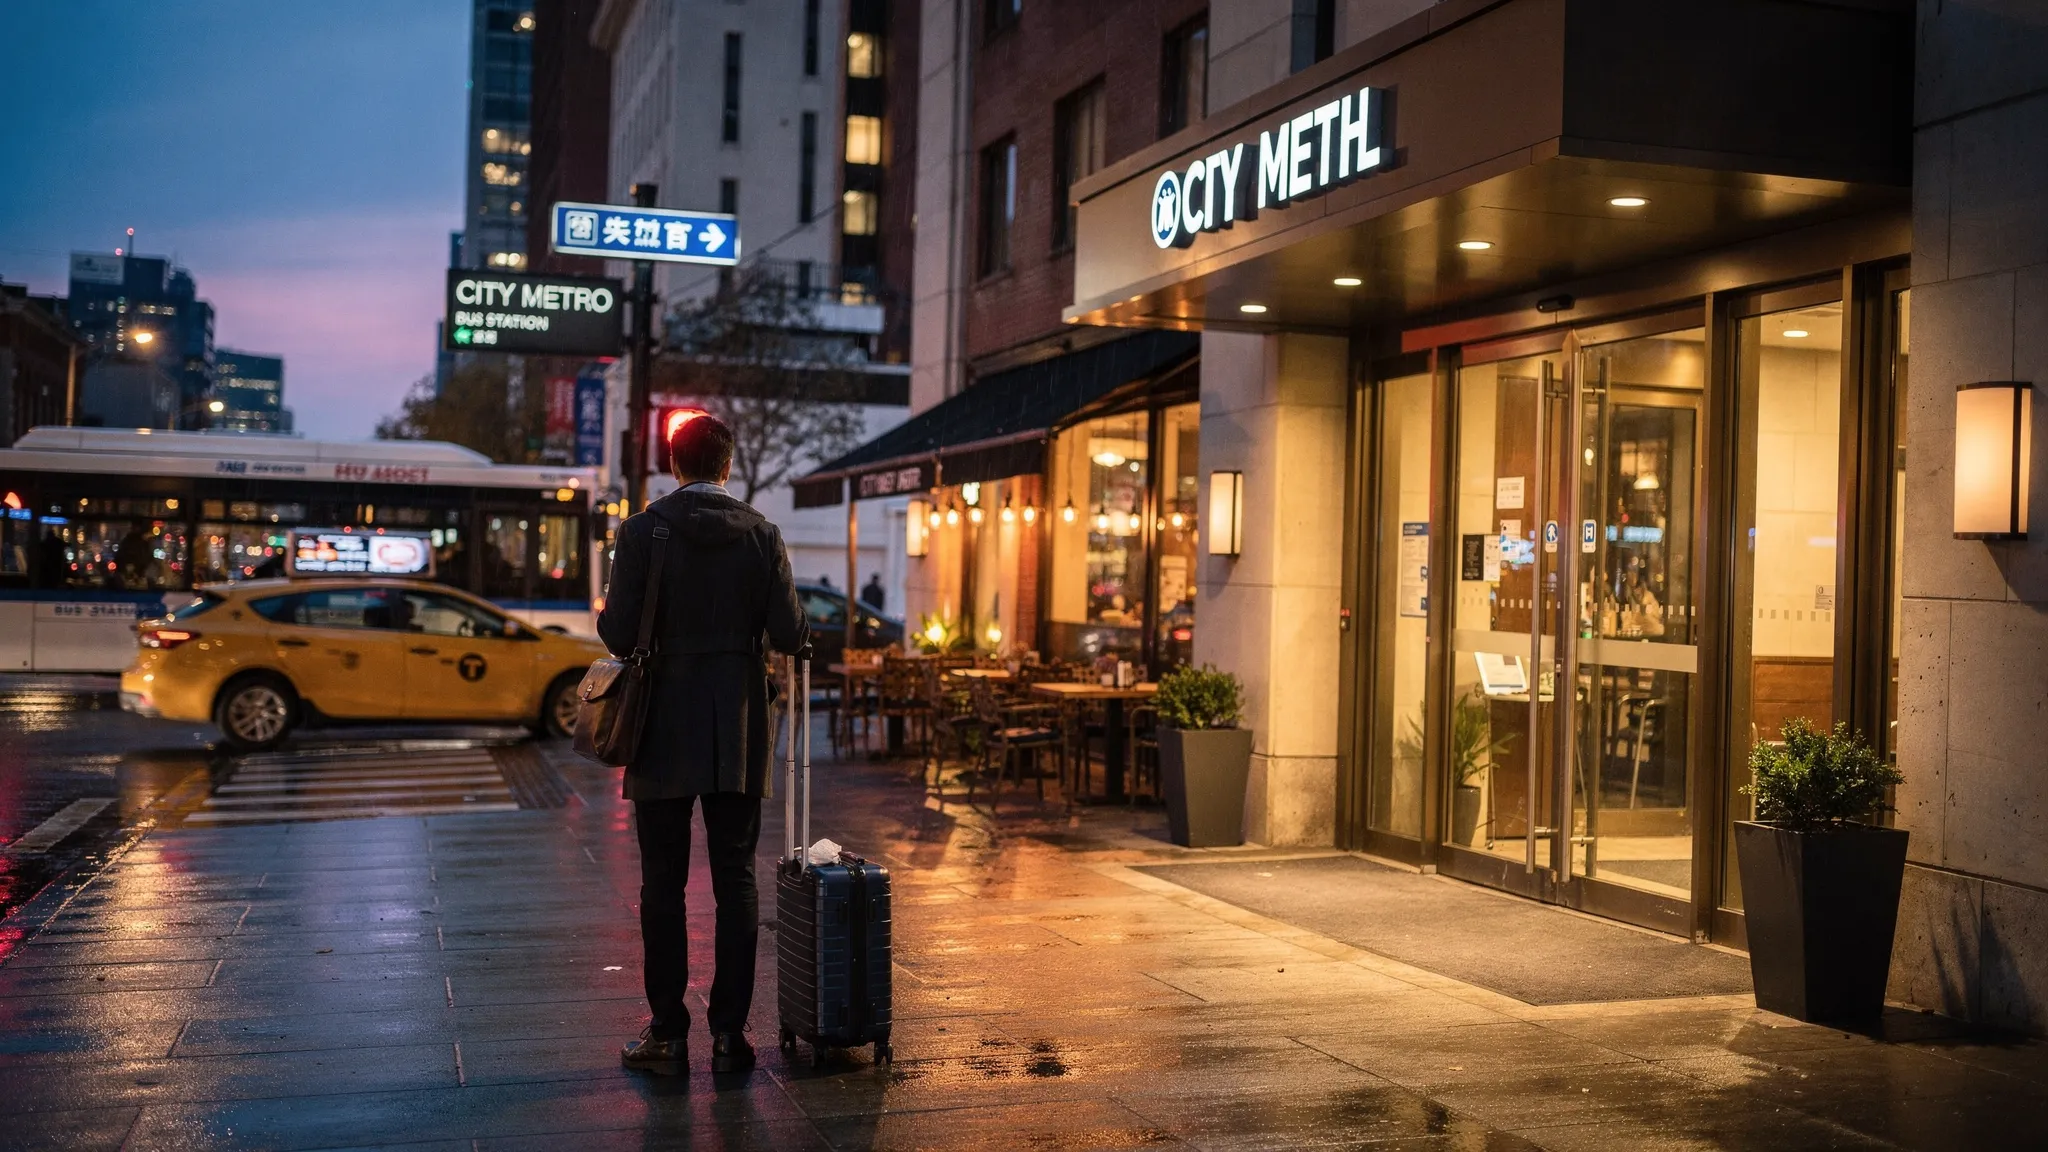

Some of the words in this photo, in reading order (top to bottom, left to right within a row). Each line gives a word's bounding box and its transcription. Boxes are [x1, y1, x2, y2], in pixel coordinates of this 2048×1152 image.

[455, 279, 517, 307] CITY
[521, 283, 614, 313] METRO
[455, 310, 484, 327] BUS
[485, 312, 550, 331] STATION
